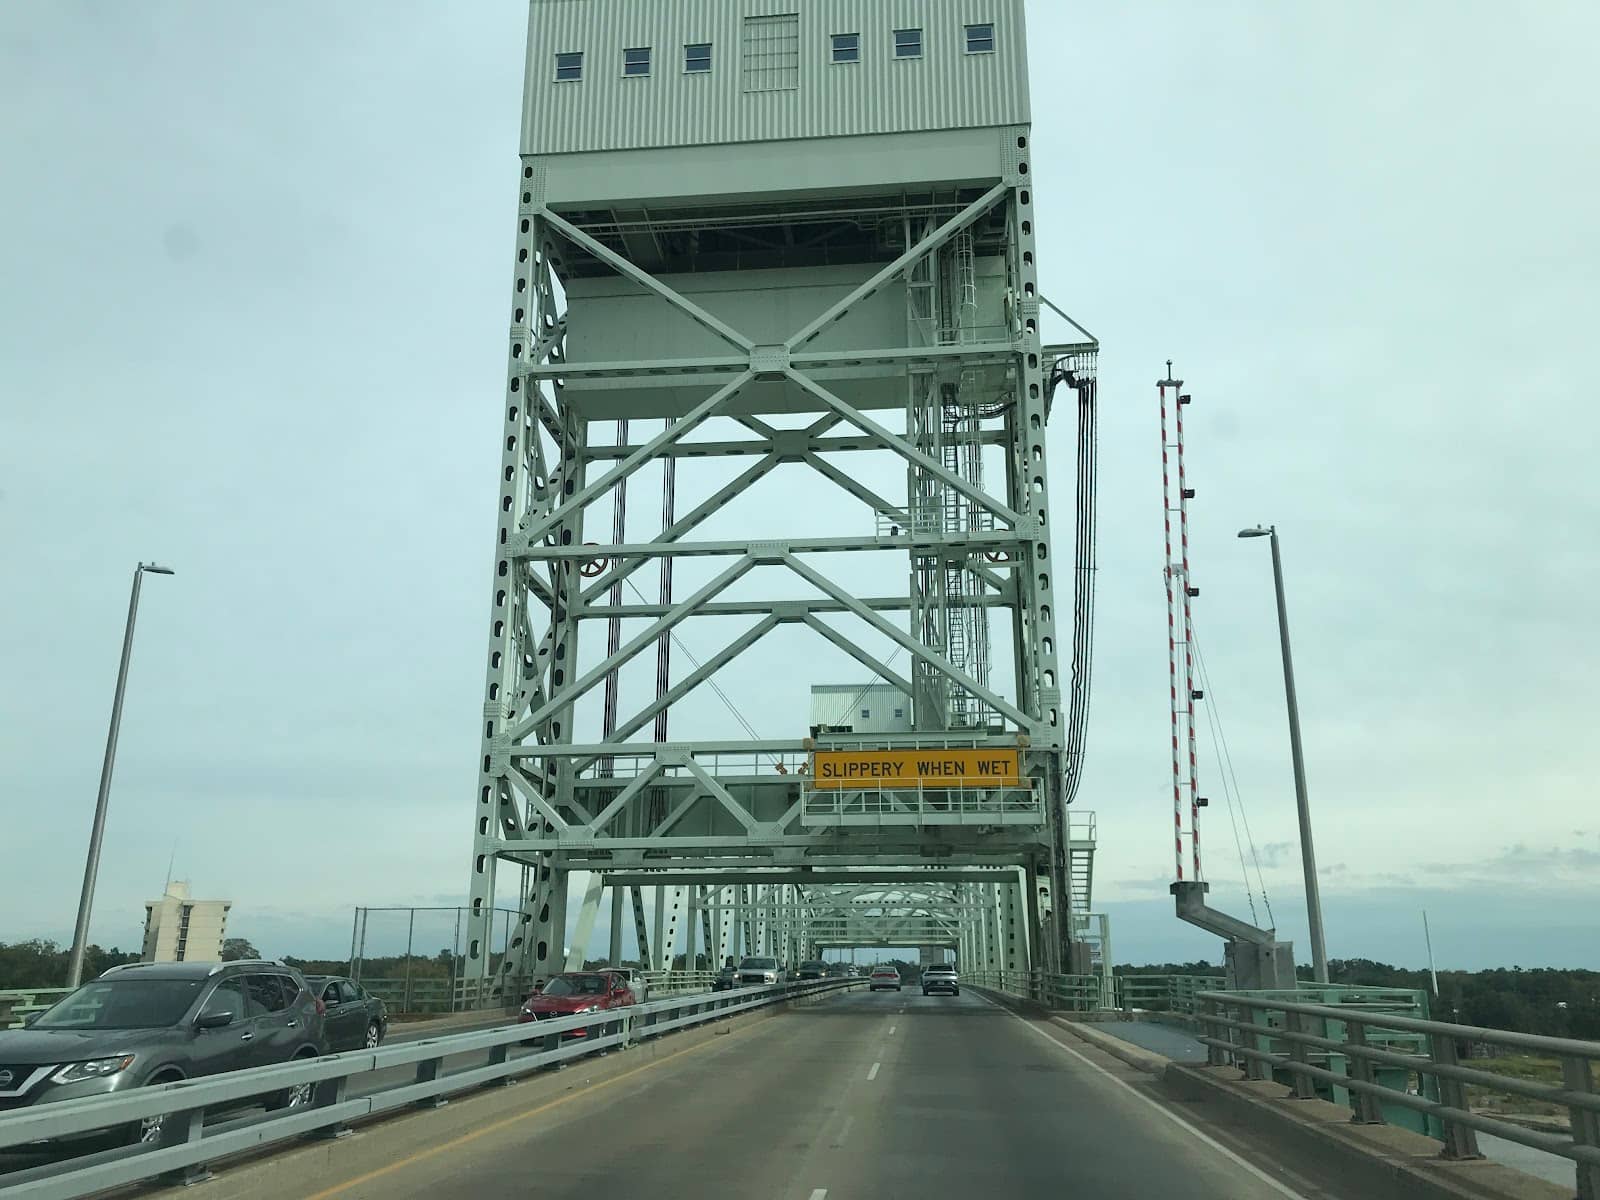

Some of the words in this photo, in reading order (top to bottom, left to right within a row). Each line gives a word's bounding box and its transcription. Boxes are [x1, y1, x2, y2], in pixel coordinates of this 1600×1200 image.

[822, 762, 904, 777] SLIPPERY
[917, 761, 965, 776] WHEN
[978, 760, 1011, 775] WET
